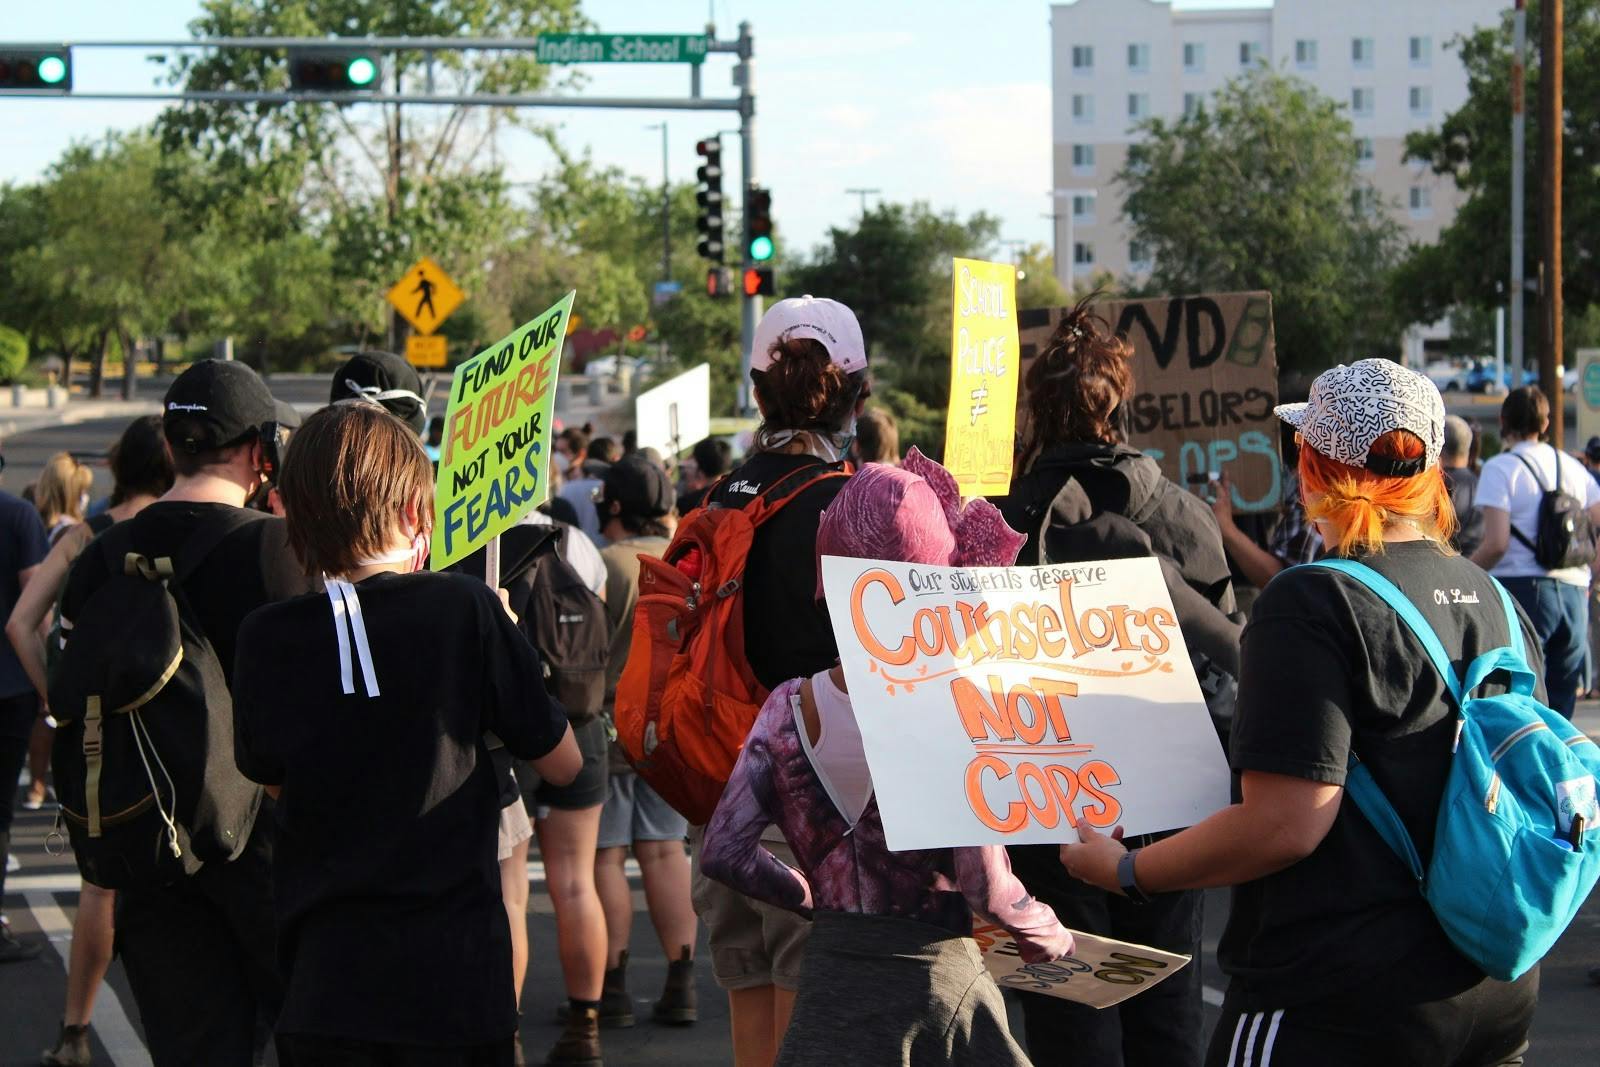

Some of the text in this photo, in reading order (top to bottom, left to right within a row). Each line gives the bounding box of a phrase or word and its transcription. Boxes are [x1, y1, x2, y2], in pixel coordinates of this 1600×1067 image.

[538, 36, 706, 61] Indian School Rd
[960, 265, 1007, 318] SCHOOL
[457, 310, 563, 403] FUND OUR
[958, 327, 1007, 378] POLICE
[444, 345, 557, 468] FUTURE
[453, 412, 542, 497] NOT YOUR
[444, 441, 541, 556] FEARS
[908, 566, 1108, 592] Our students deserve
[1434, 589, 1449, 604] Oh
[850, 567, 1177, 665] Counselors
[950, 675, 1079, 744] NOT
[963, 754, 1123, 833] COPS
[1094, 952, 1169, 985] NO
